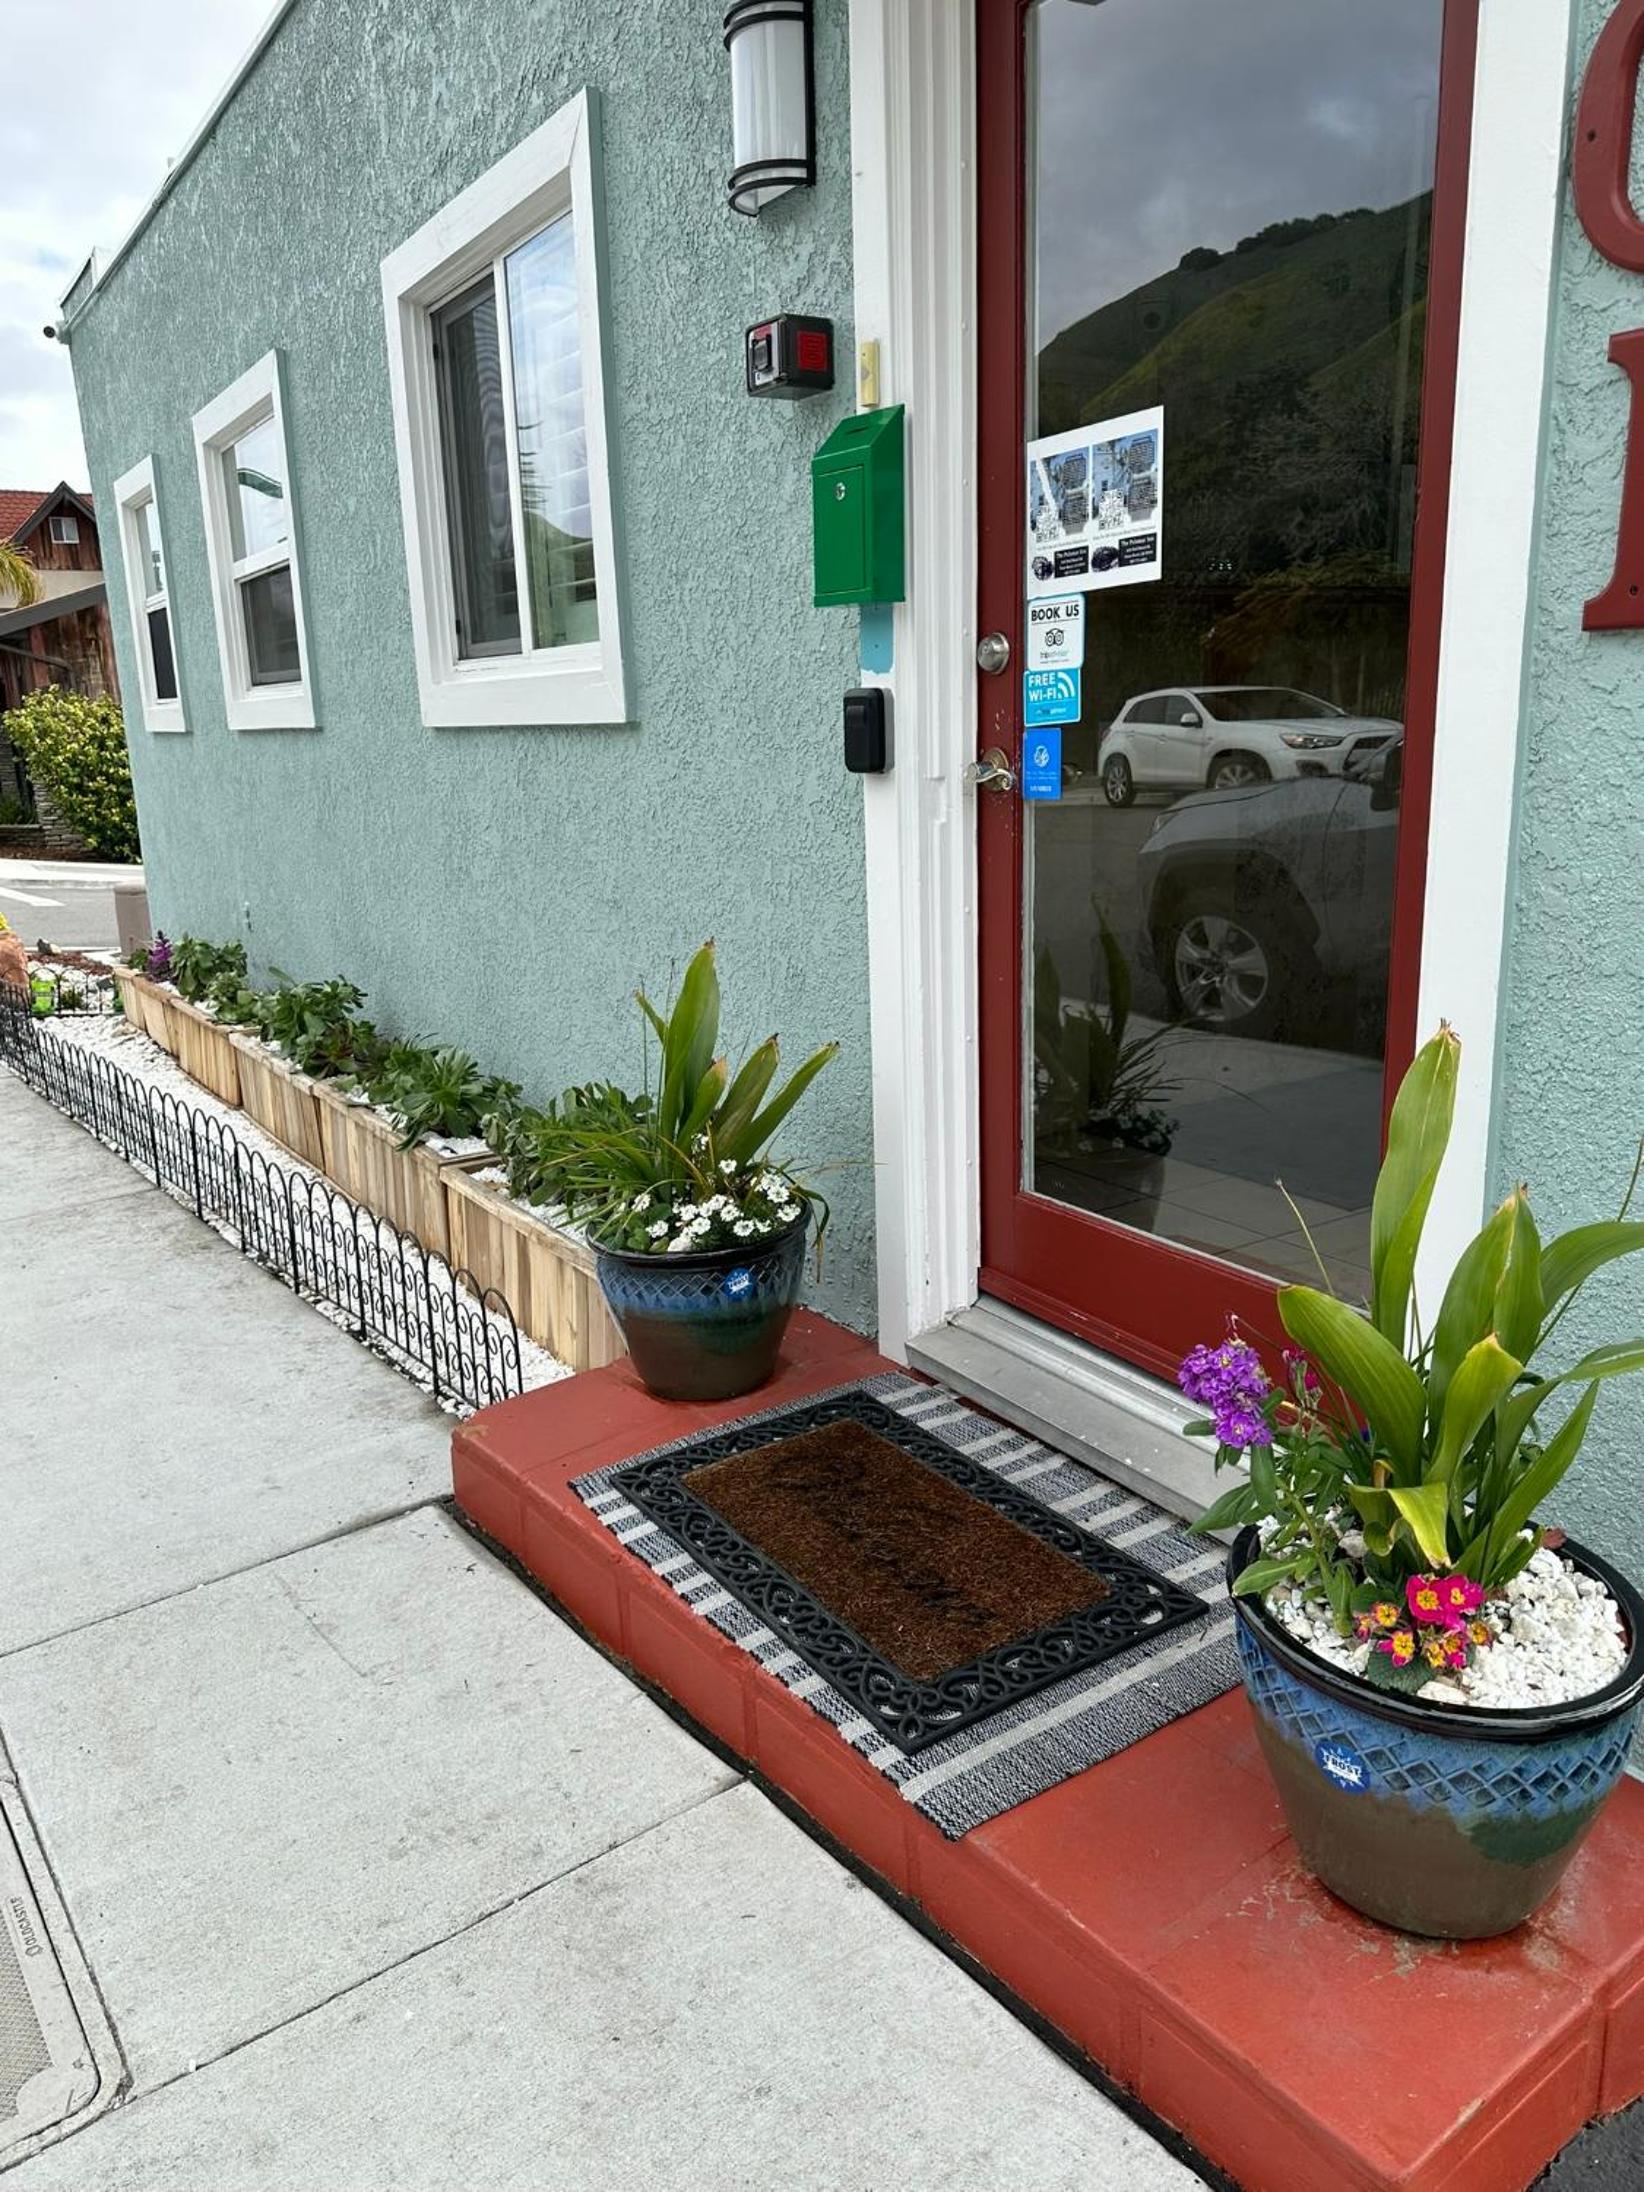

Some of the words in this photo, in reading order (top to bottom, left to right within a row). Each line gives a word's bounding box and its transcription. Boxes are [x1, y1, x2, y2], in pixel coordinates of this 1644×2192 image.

[1031, 606, 1060, 622] BOOK
[1066, 604, 1079, 617] US
[1028, 673, 1056, 687] FREE
[1029, 688, 1057, 702] WI-FI
